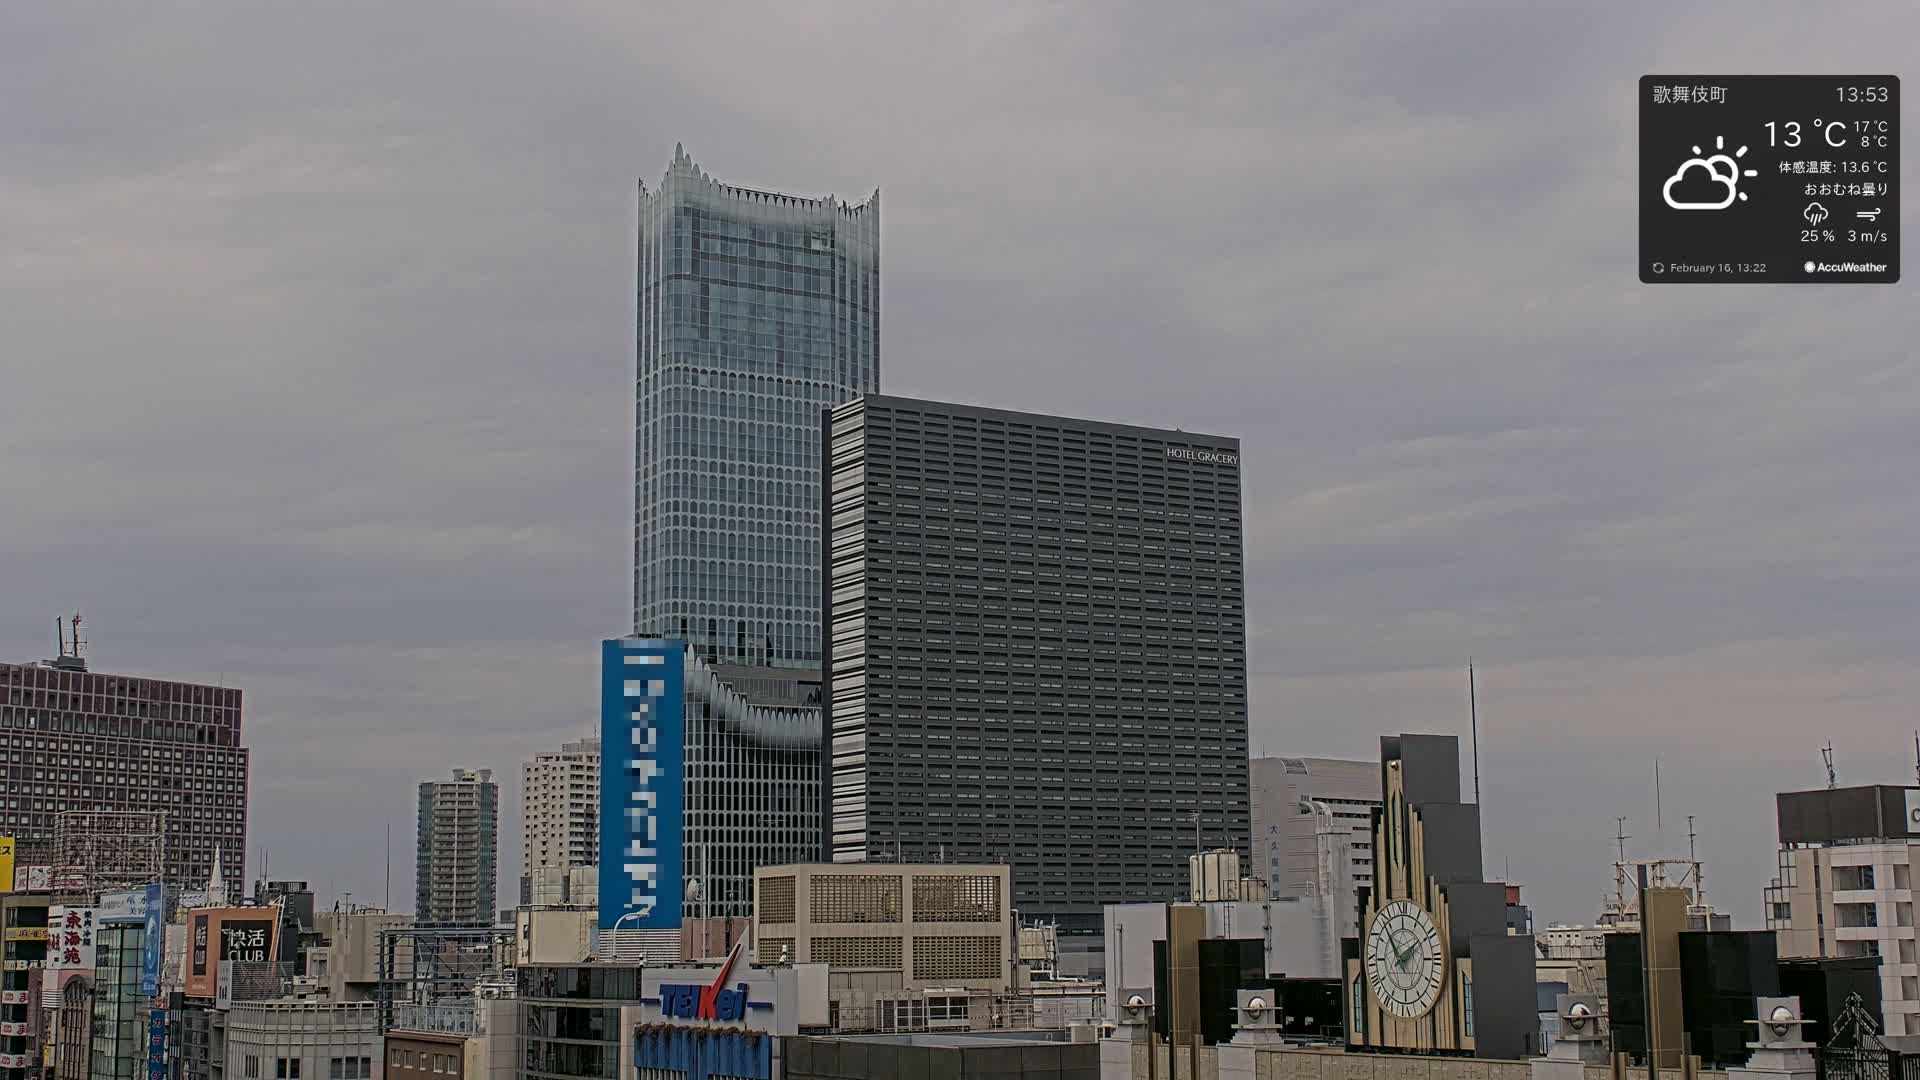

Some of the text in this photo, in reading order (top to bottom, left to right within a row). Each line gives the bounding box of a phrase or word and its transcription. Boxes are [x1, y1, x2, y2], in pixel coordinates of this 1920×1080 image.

[1167, 448, 1239, 464] HOTEL GRACERY
[62, 910, 82, 964] 東海苑
[229, 950, 264, 962] CLUB
